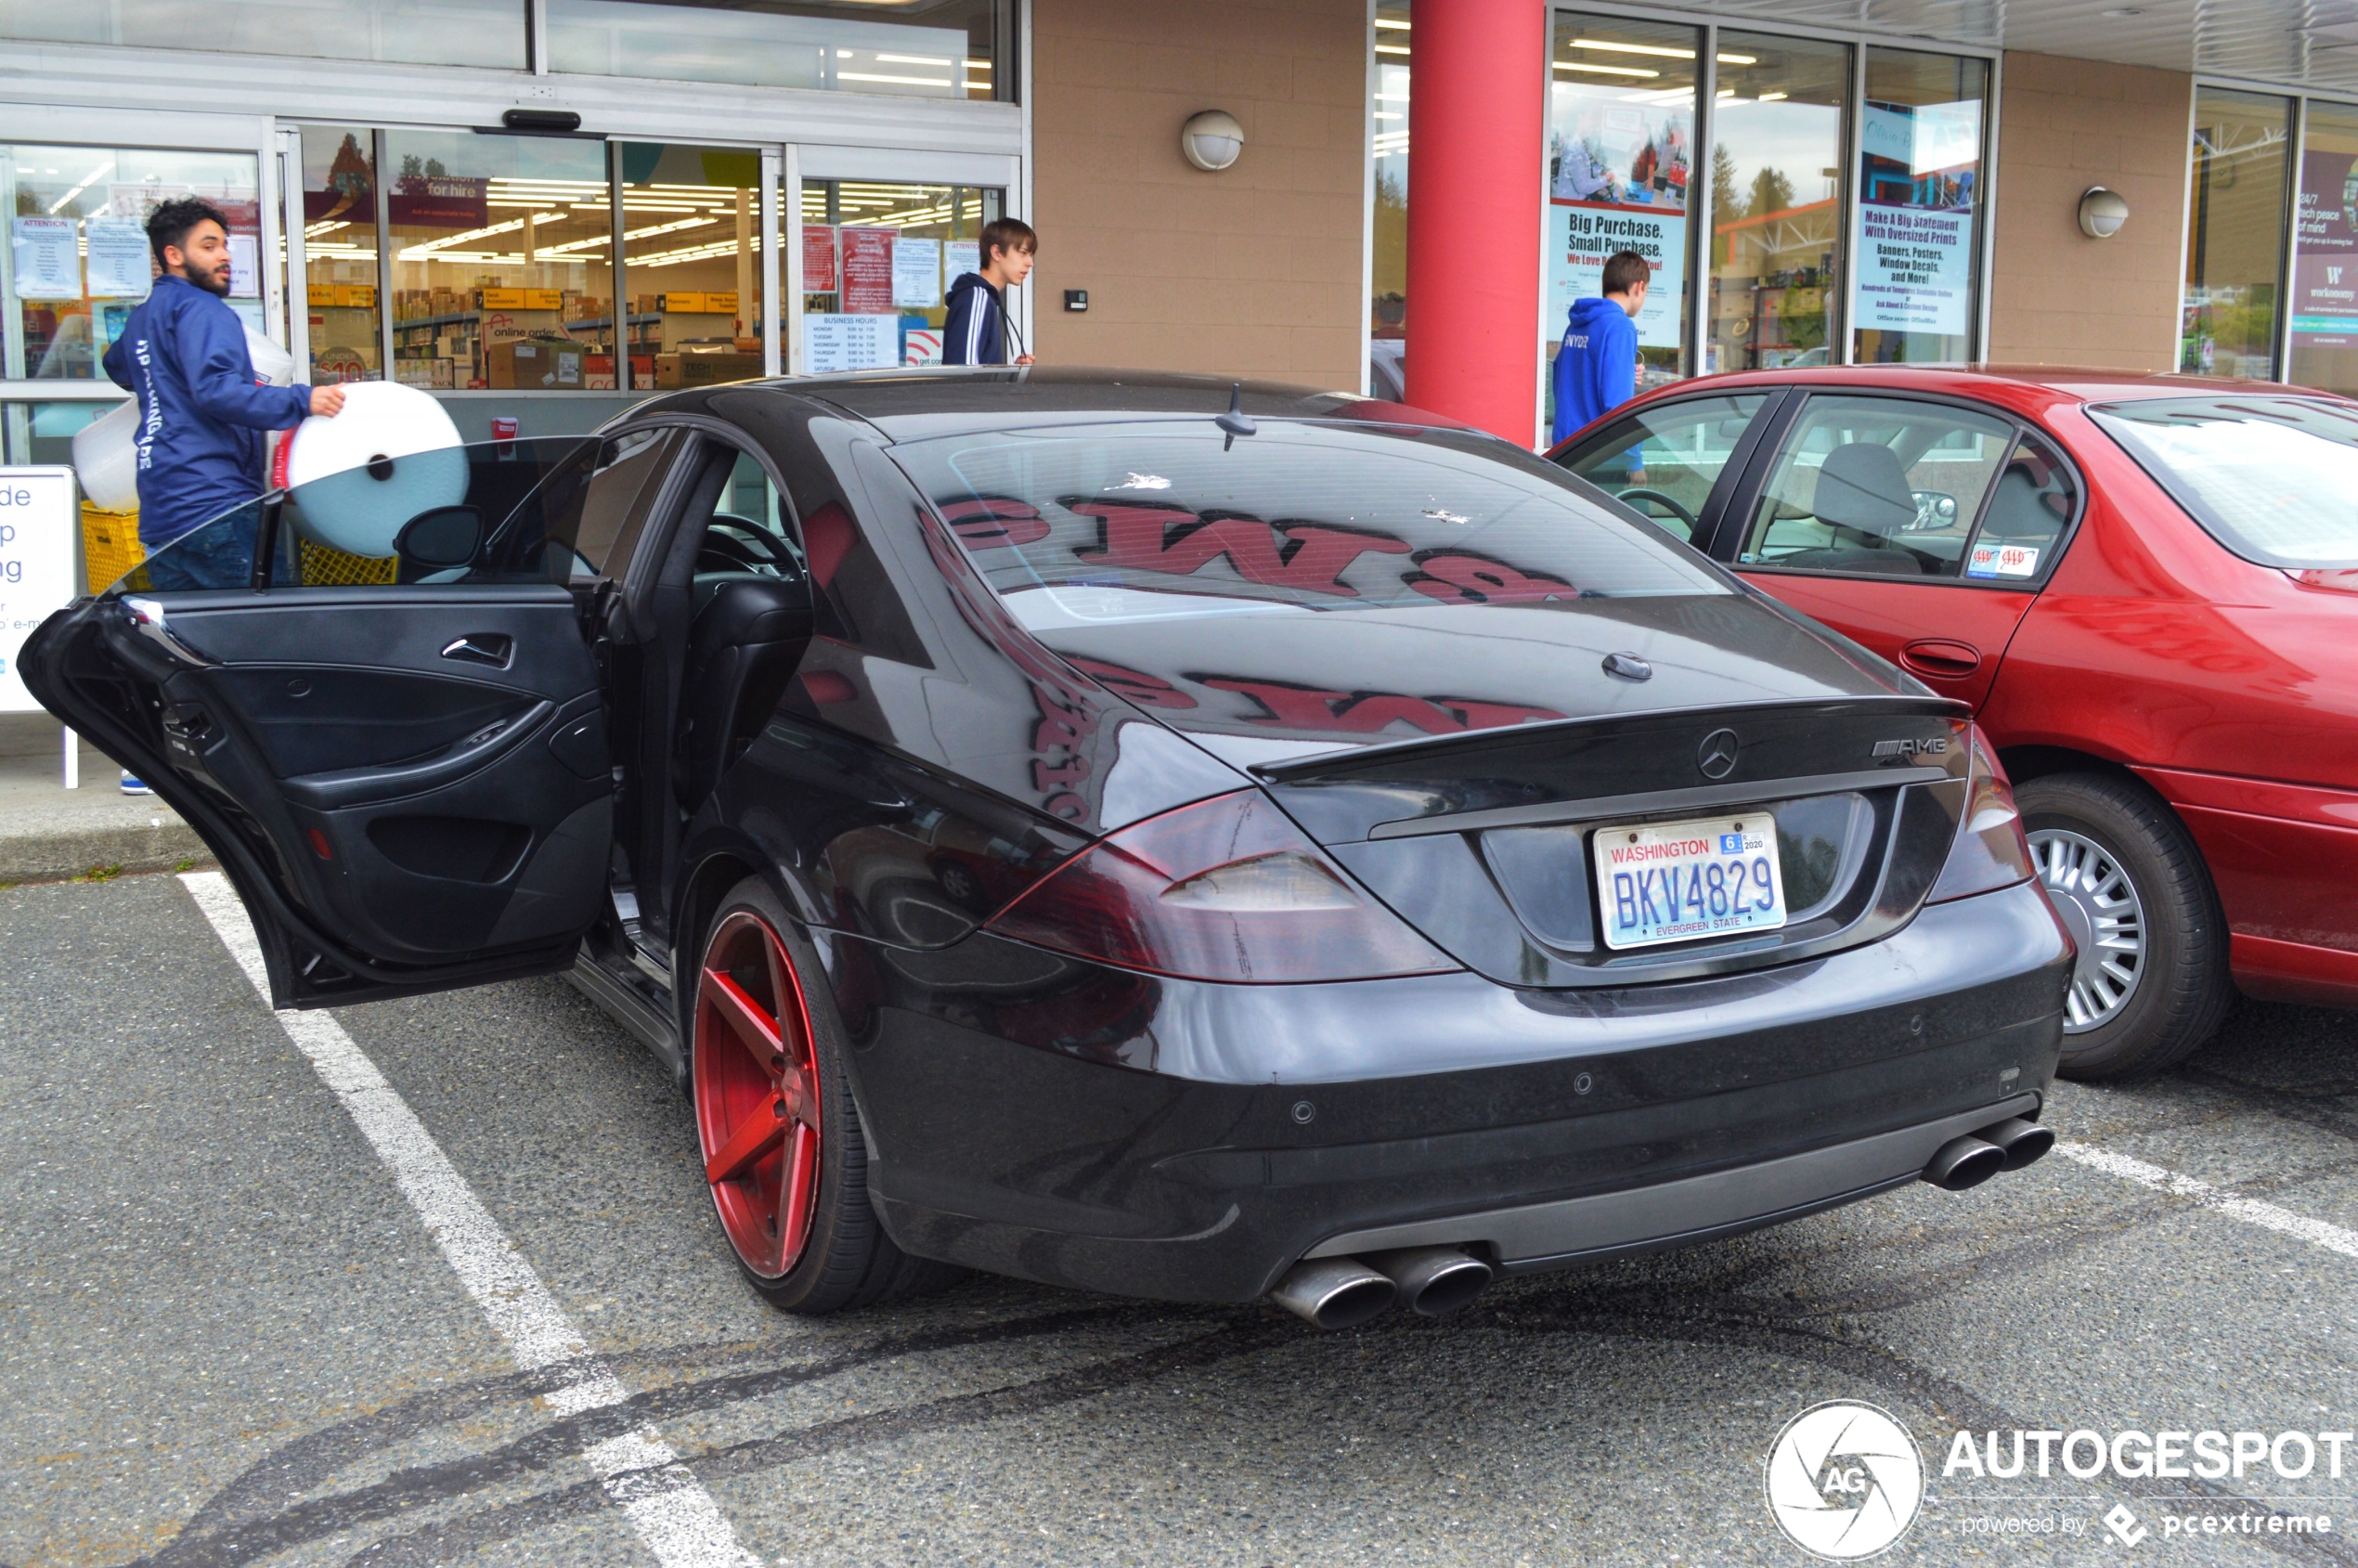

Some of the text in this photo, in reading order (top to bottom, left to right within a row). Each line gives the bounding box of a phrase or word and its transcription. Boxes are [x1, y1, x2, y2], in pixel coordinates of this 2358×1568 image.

[427, 183, 476, 197] for hire
[1865, 211, 1959, 231] Make A Big Statement
[2315, 210, 2339, 224] peace
[1569, 214, 1663, 239] Big Purchase.
[2307, 222, 2326, 233] mind
[1865, 225, 1957, 245] With Oversized Prints
[1569, 234, 1662, 257] Small Purchase.
[1877, 244, 1944, 261] Banners, Posters,
[1567, 253, 1580, 264] We
[1582, 255, 1600, 266] Love
[1880, 257, 1940, 273] Window Decals,
[1891, 272, 1929, 285] and More!
[1861, 284, 1886, 292] Hundreds
[1892, 286, 1916, 295] Templates
[2310, 288, 2355, 302] workonomy
[478, 296, 483, 304] 7
[494, 328, 556, 337] online order
[320, 360, 363, 382] $10
[1974, 549, 2025, 565] AAA AAA
[1898, 739, 1946, 754] AMG
[1726, 836, 1735, 849] 6
[1611, 839, 1709, 864] WASHINGTON
[1745, 840, 1763, 849] 2020
[1614, 857, 1774, 929] BKV4829
[1656, 917, 1741, 936] EVERGREEN STATE
